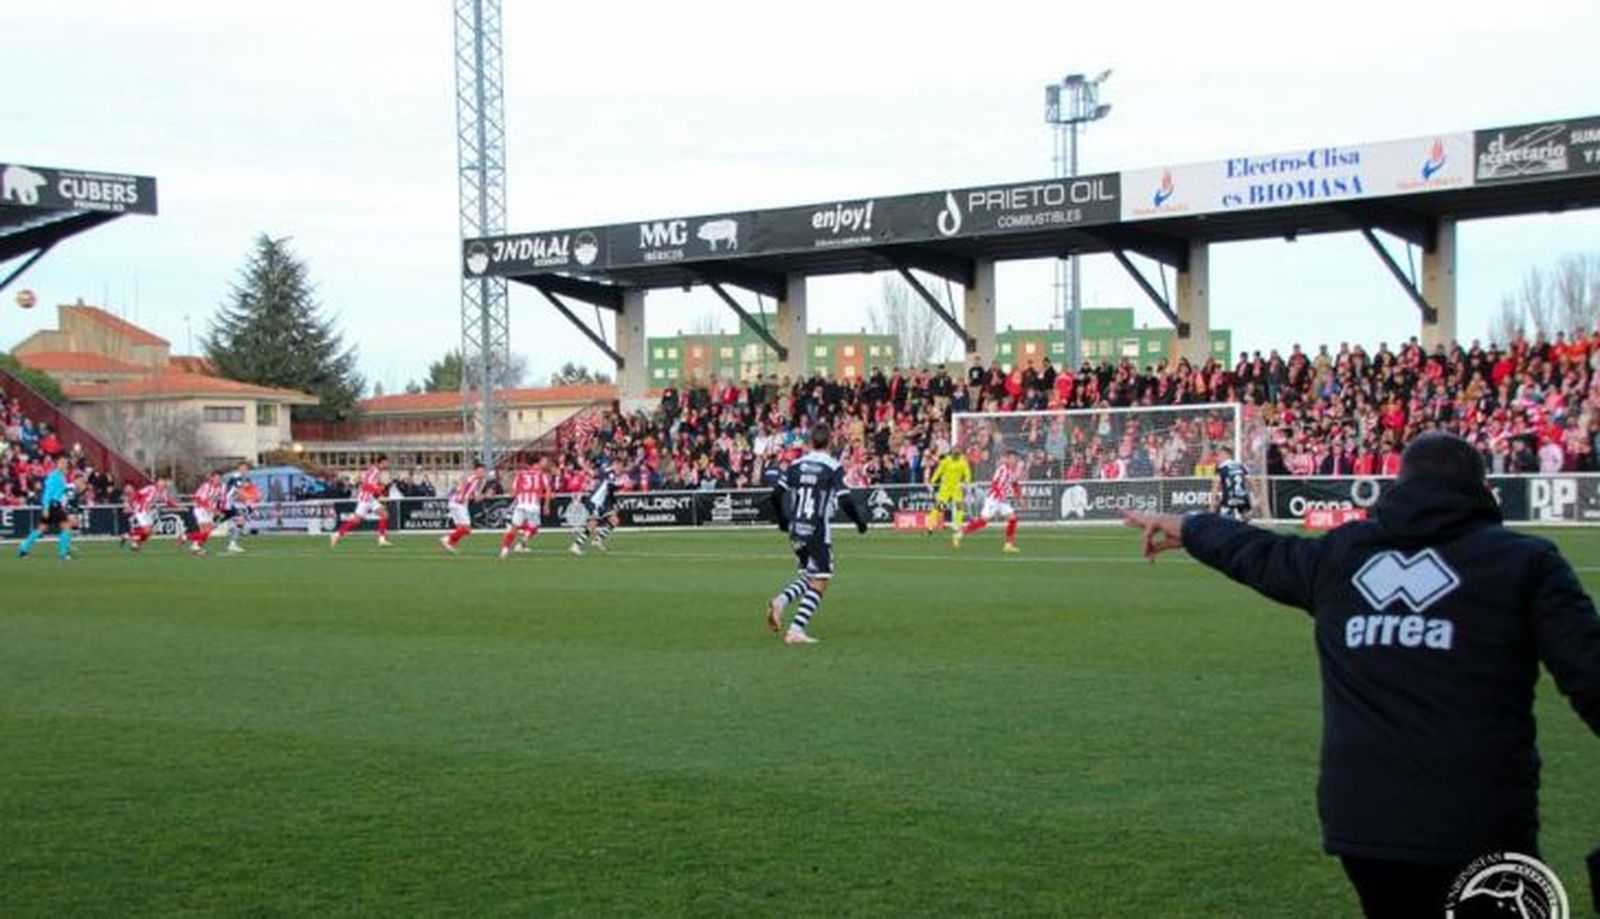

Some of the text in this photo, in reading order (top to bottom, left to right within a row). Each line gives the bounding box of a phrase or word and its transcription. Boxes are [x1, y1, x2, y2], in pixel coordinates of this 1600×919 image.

[58, 178, 138, 204] CUBERS
[968, 179, 1114, 212] PRIETO OIL
[1249, 175, 1363, 204] BIOMASA
[812, 201, 874, 233] enjoy!
[996, 208, 1083, 228] COMBUSTIBLES
[797, 487, 815, 519] 14
[1346, 615, 1454, 650] errea
